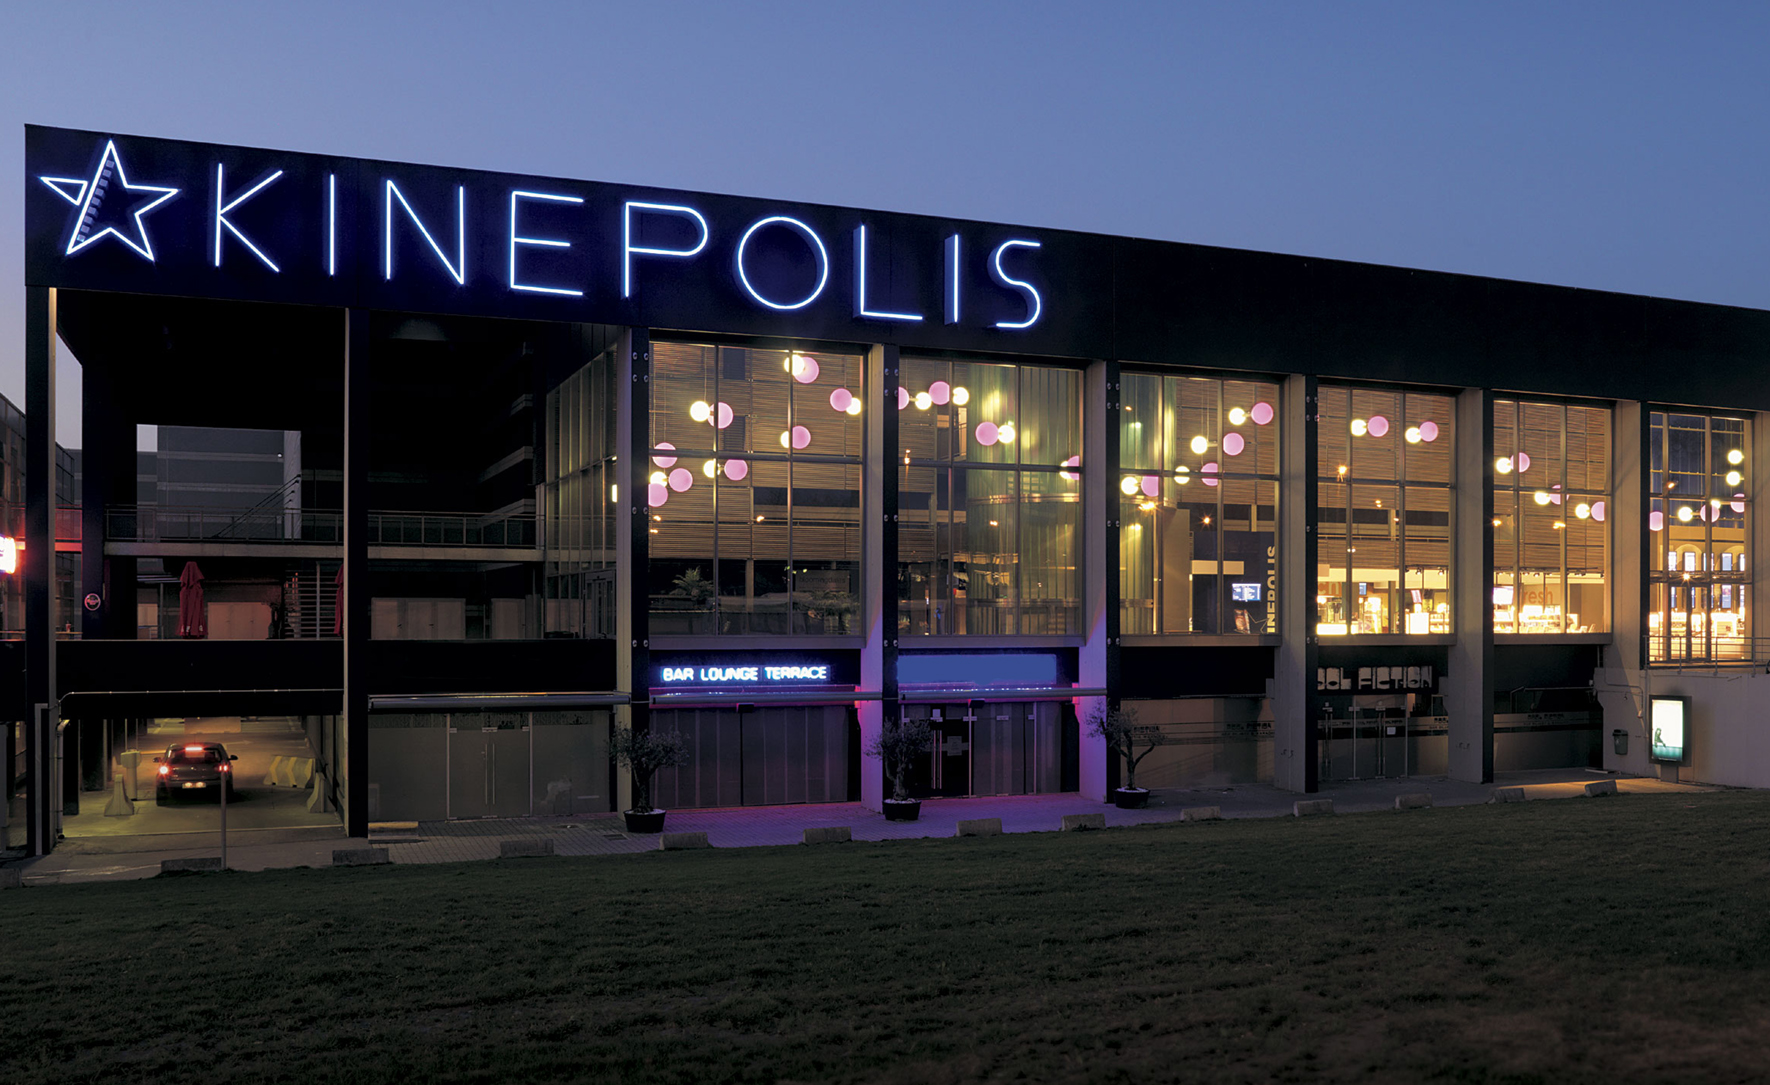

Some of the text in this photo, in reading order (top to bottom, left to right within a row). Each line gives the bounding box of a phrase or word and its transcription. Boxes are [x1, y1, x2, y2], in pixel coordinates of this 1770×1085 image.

[214, 163, 1043, 330] KINEPOLIS
[662, 665, 827, 682] BAR LOUNGE TERRACE
[1358, 665, 1433, 690] FICTION
